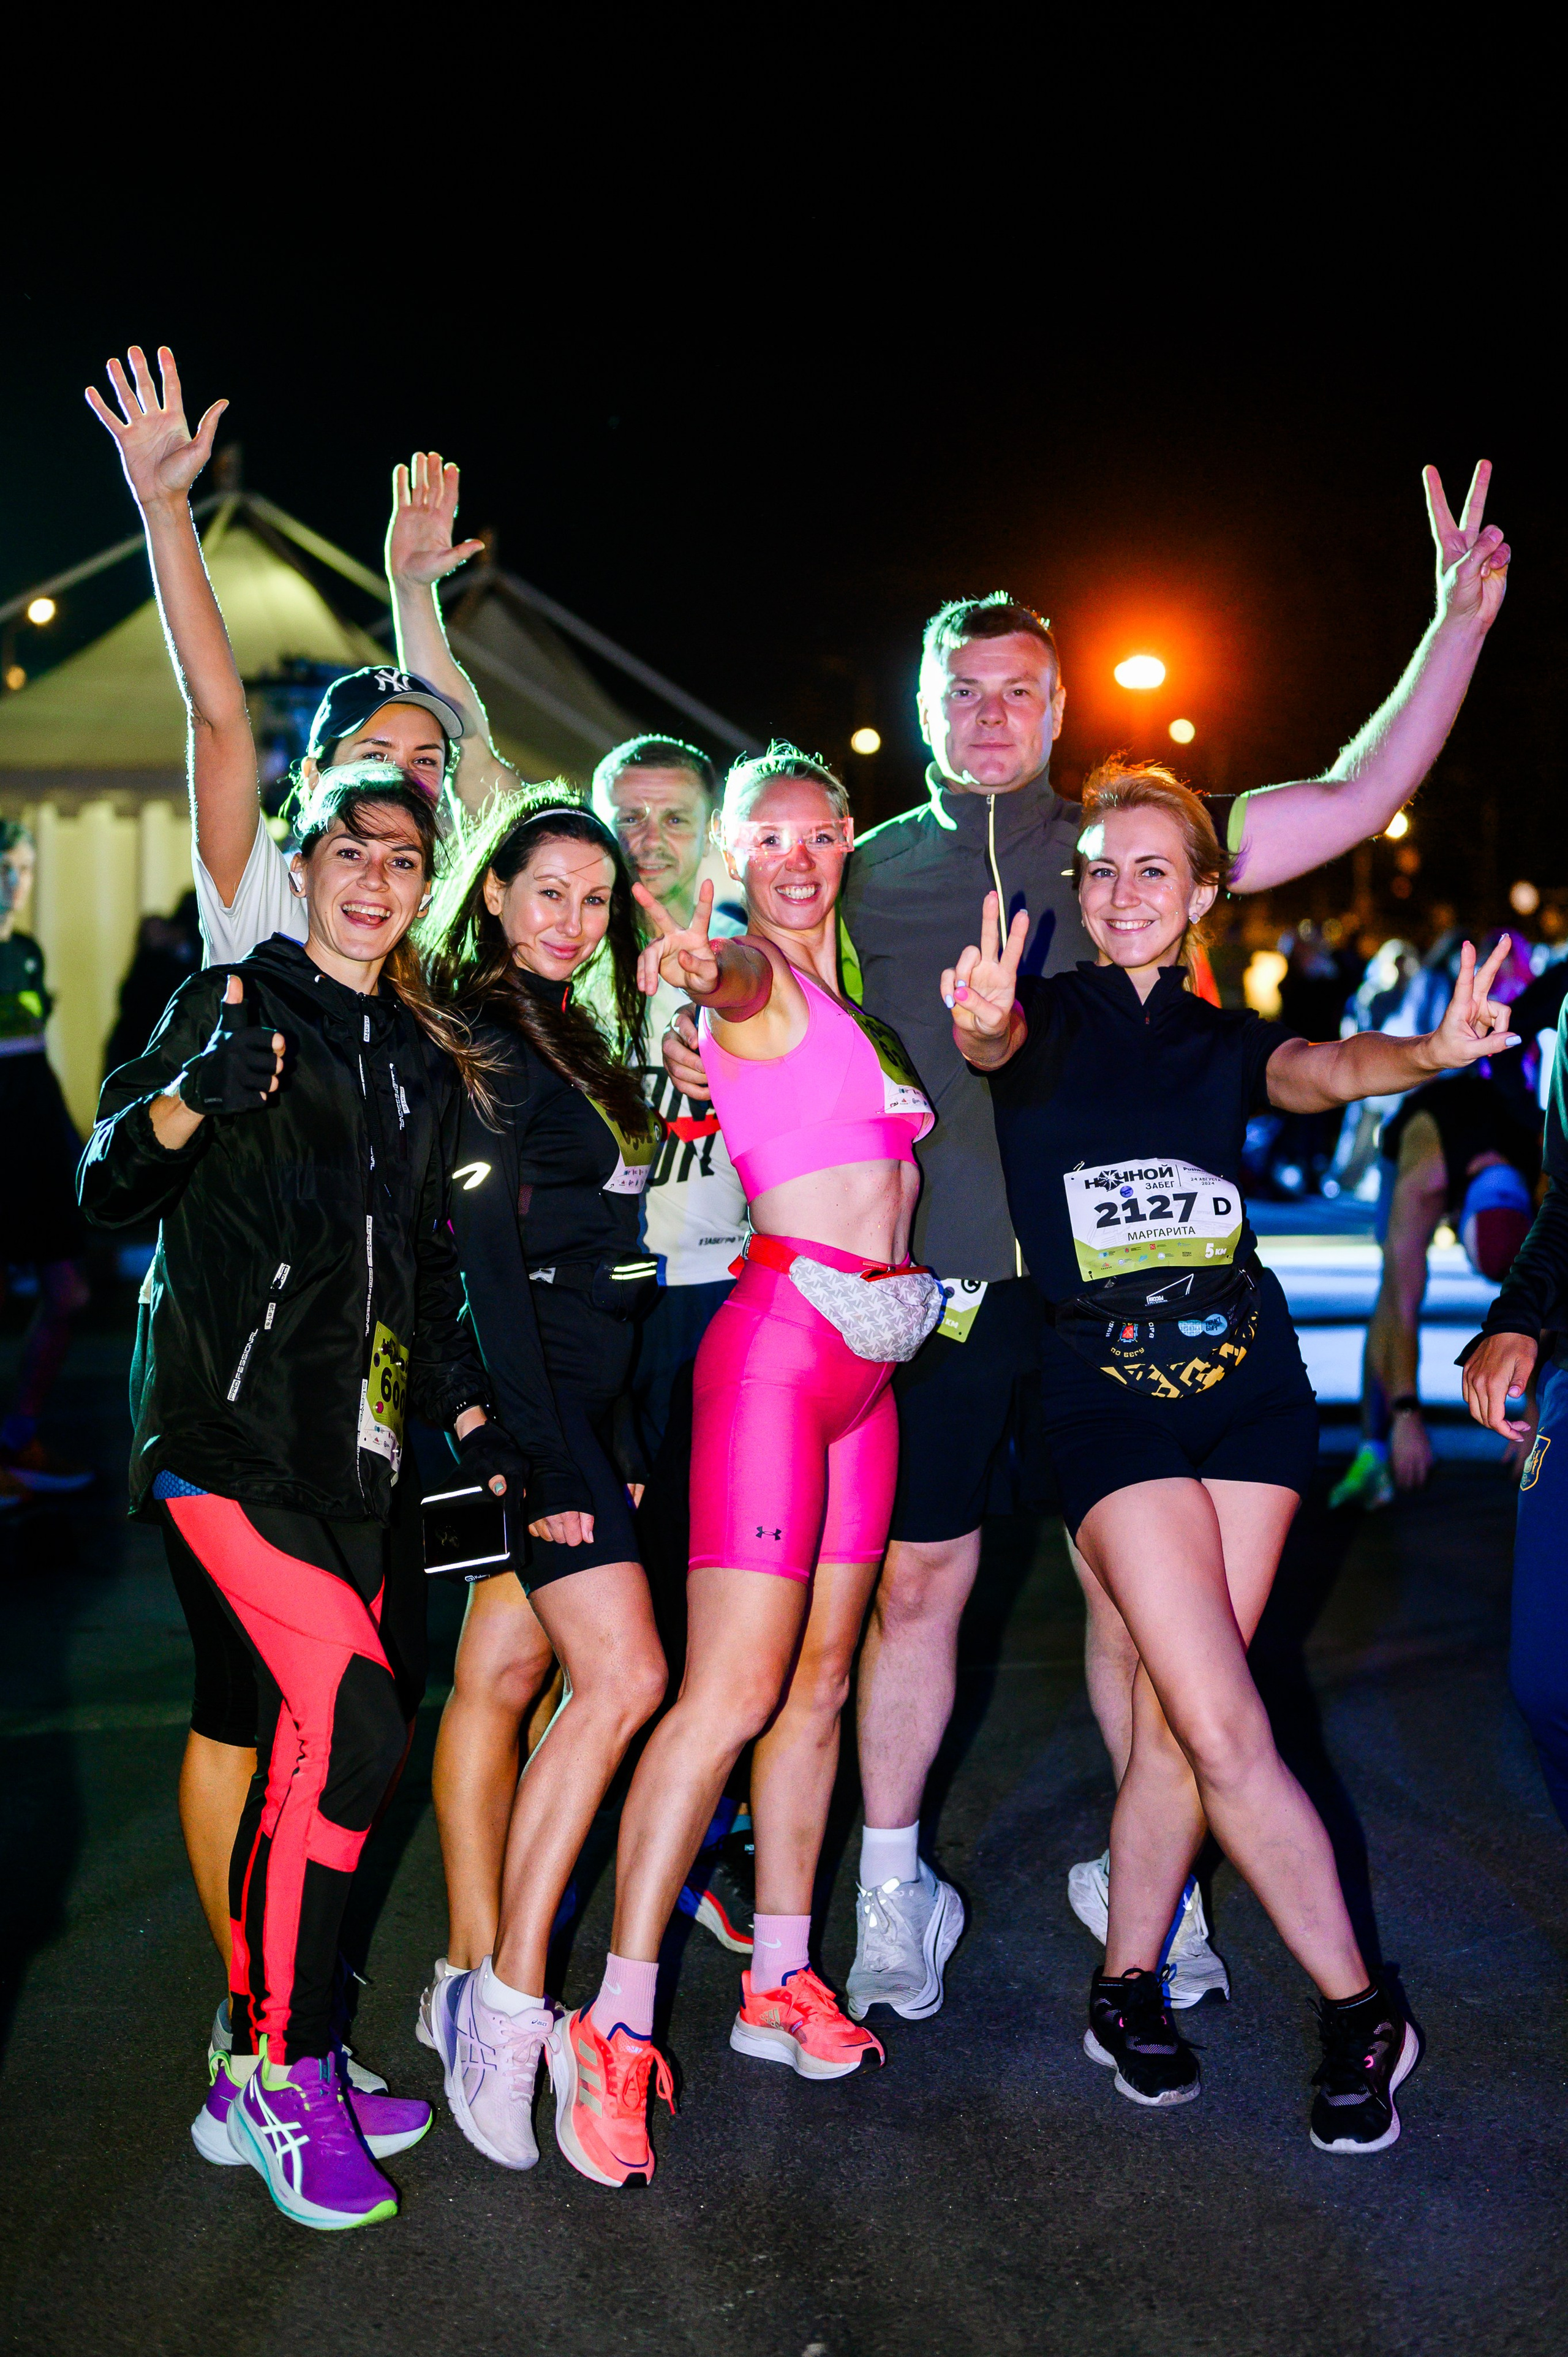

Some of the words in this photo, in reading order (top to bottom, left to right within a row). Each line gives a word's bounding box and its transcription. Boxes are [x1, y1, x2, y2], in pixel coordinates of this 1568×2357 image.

[374, 669, 413, 692] NY
[1145, 1181, 1175, 1190] ЗАБЕГ
[1094, 1192, 1198, 1229] 2127
[1213, 1197, 1232, 1216] D
[1128, 1226, 1196, 1241] МАРГАРИТА
[1205, 1243, 1214, 1258] 5
[1124, 1348, 1145, 1357] БЕГУ
[227, 1329, 258, 1401] PROFESSIONAL
